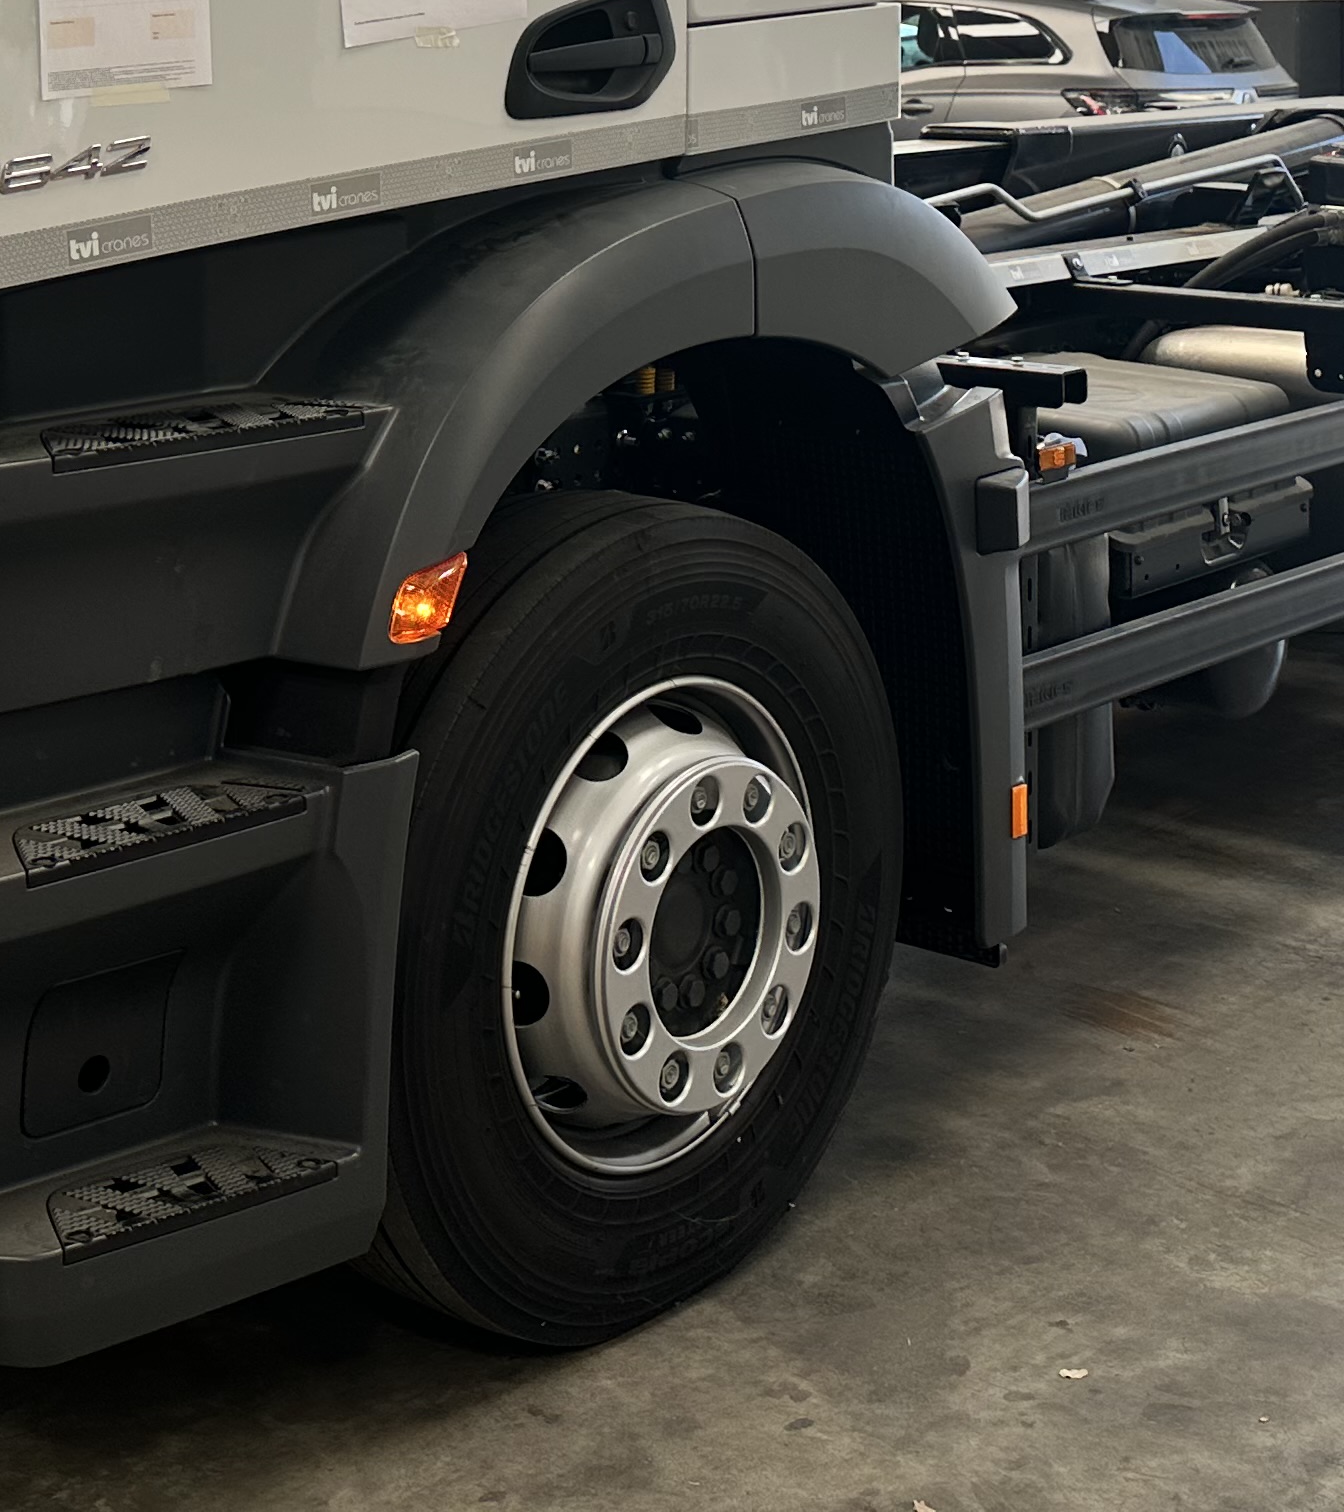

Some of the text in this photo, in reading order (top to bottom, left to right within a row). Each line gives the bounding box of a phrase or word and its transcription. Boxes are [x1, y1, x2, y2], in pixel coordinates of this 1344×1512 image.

[801, 105, 819, 127] tvi
[514, 150, 536, 174] tvi
[312, 186, 337, 212] tvi
[69, 231, 150, 261] tvi cranes
